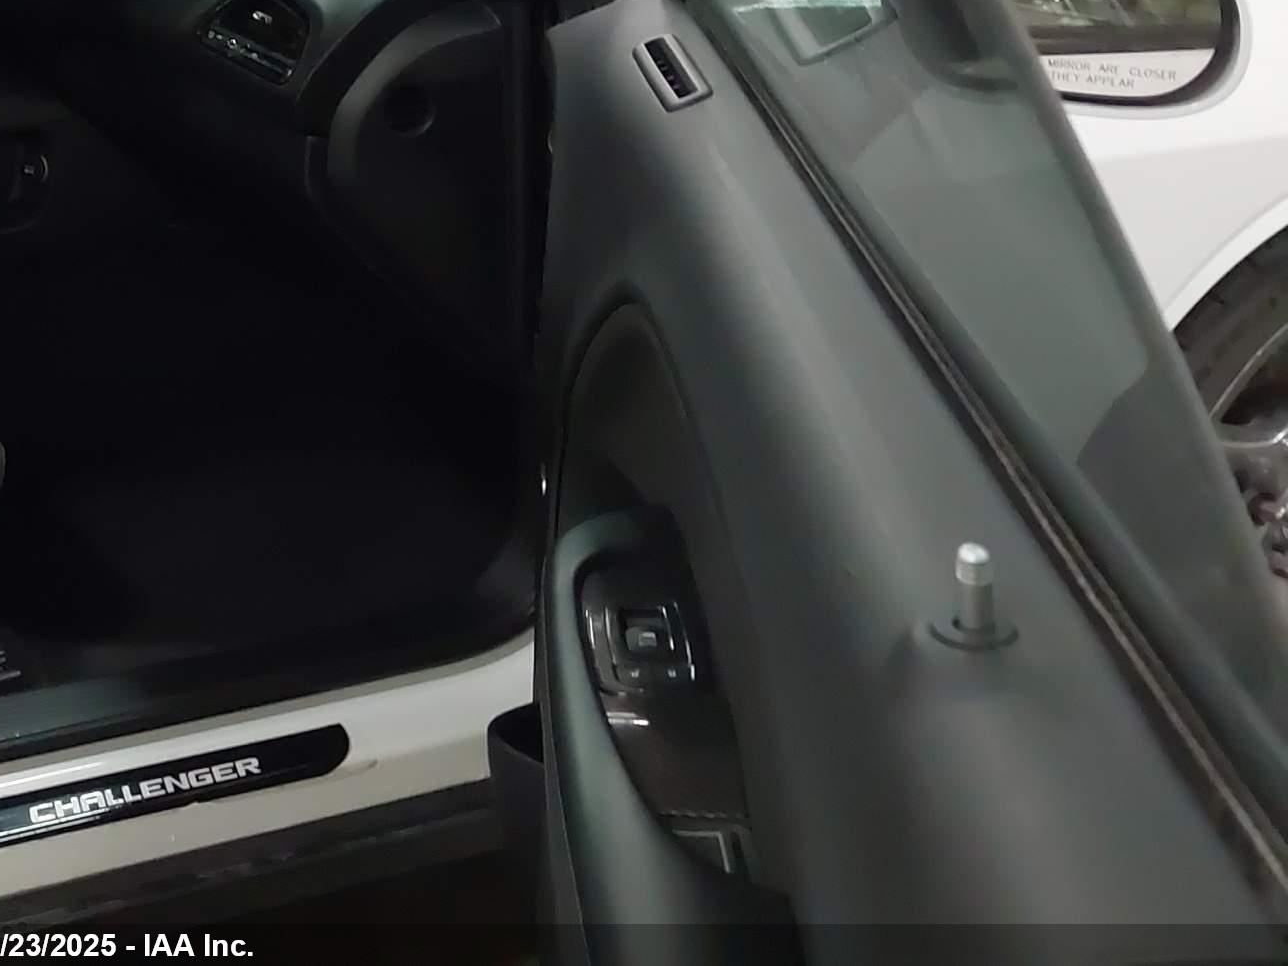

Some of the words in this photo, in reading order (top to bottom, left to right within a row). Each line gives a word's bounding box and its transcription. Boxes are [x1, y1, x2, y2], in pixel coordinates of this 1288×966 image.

[1048, 58, 1090, 71] MIRROR
[1098, 63, 1119, 75] ARE
[1128, 66, 1177, 81] CLOSER
[1051, 71, 1079, 82] THEY
[1086, 74, 1135, 88] APPEAR
[29, 757, 261, 824] CHALLENGER
